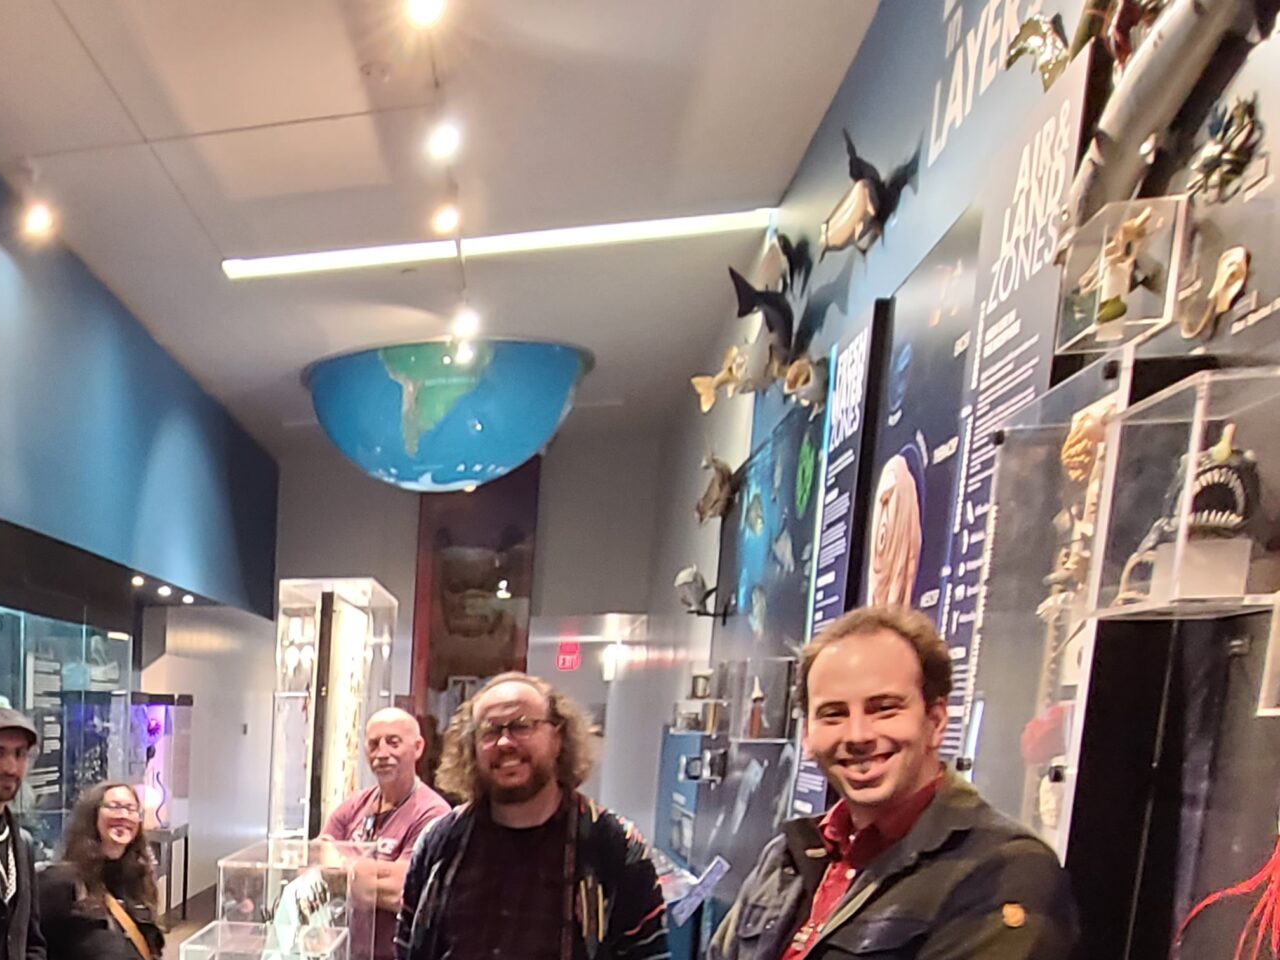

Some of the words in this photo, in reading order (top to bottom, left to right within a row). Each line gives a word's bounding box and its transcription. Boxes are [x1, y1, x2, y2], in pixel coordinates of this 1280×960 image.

[999, 154, 1066, 263] LAND
[986, 220, 1058, 315] ZONES
[558, 654, 580, 668] EXIT
